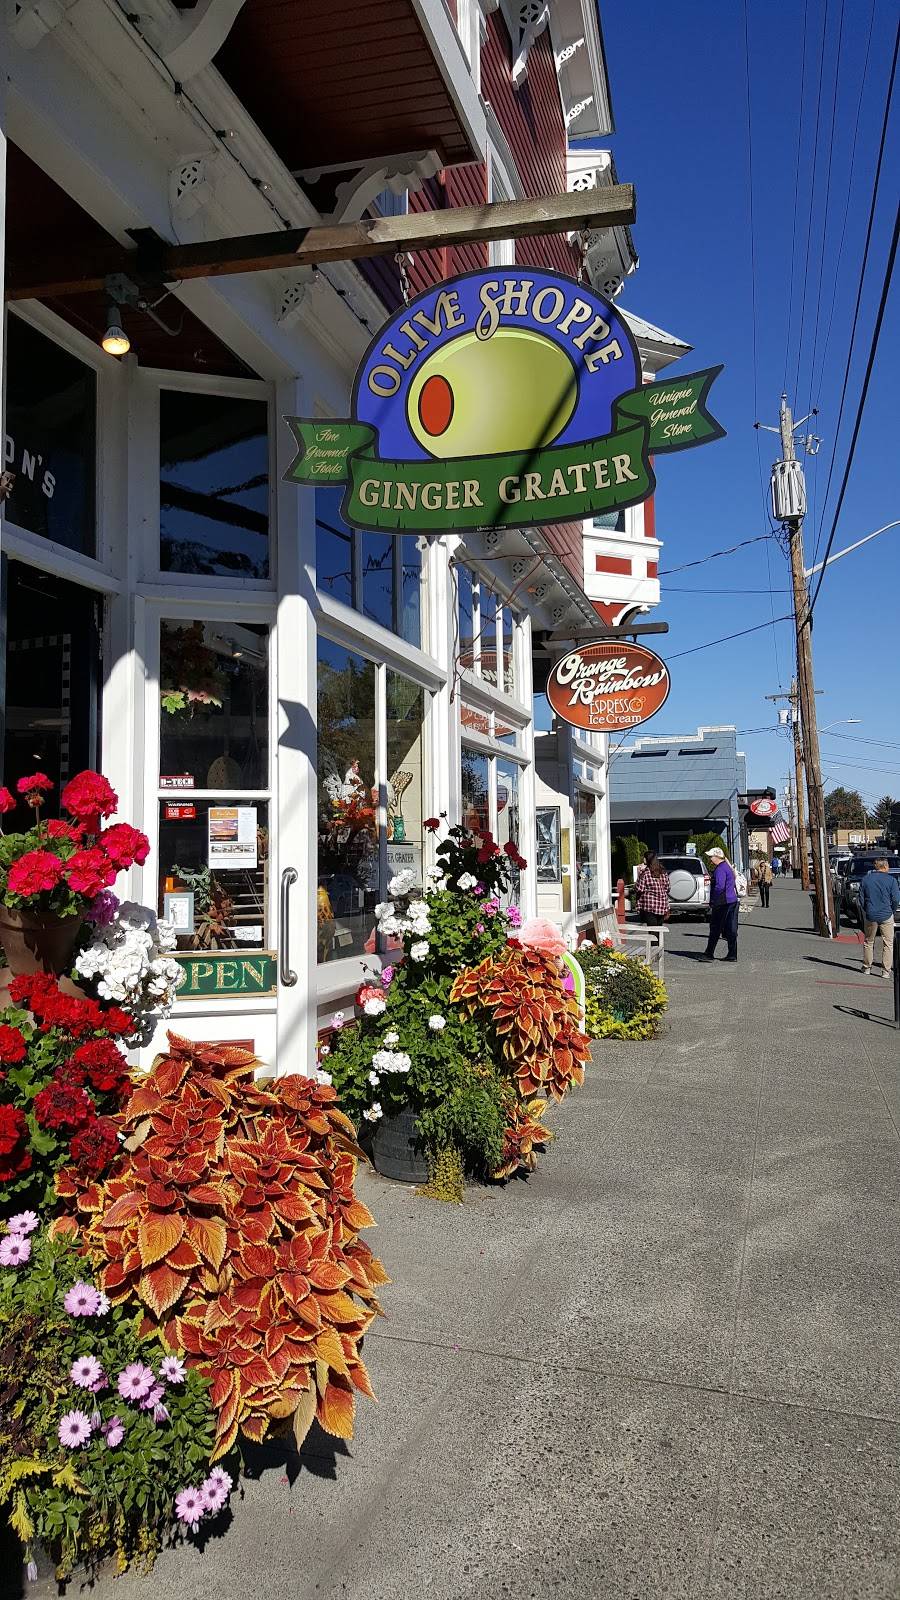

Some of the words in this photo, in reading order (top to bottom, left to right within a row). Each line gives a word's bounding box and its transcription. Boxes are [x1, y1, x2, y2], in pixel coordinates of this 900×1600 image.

[367, 290, 466, 398] OLIVE
[475, 279, 624, 374] SHOPPE
[648, 388, 692, 406] Unique
[650, 400, 698, 427] General
[316, 429, 340, 442] Fine
[660, 424, 692, 438] Store
[304, 445, 350, 461] Gourmet
[311, 461, 343, 474] Foods
[359, 479, 484, 511] GINGER
[498, 454, 639, 504] GRATER
[557, 654, 629, 685] Orange
[568, 666, 666, 706] Rainbow
[590, 697, 646, 714] ESPRESSO
[589, 715, 606, 724] Ice
[606, 714, 642, 724] Cream
